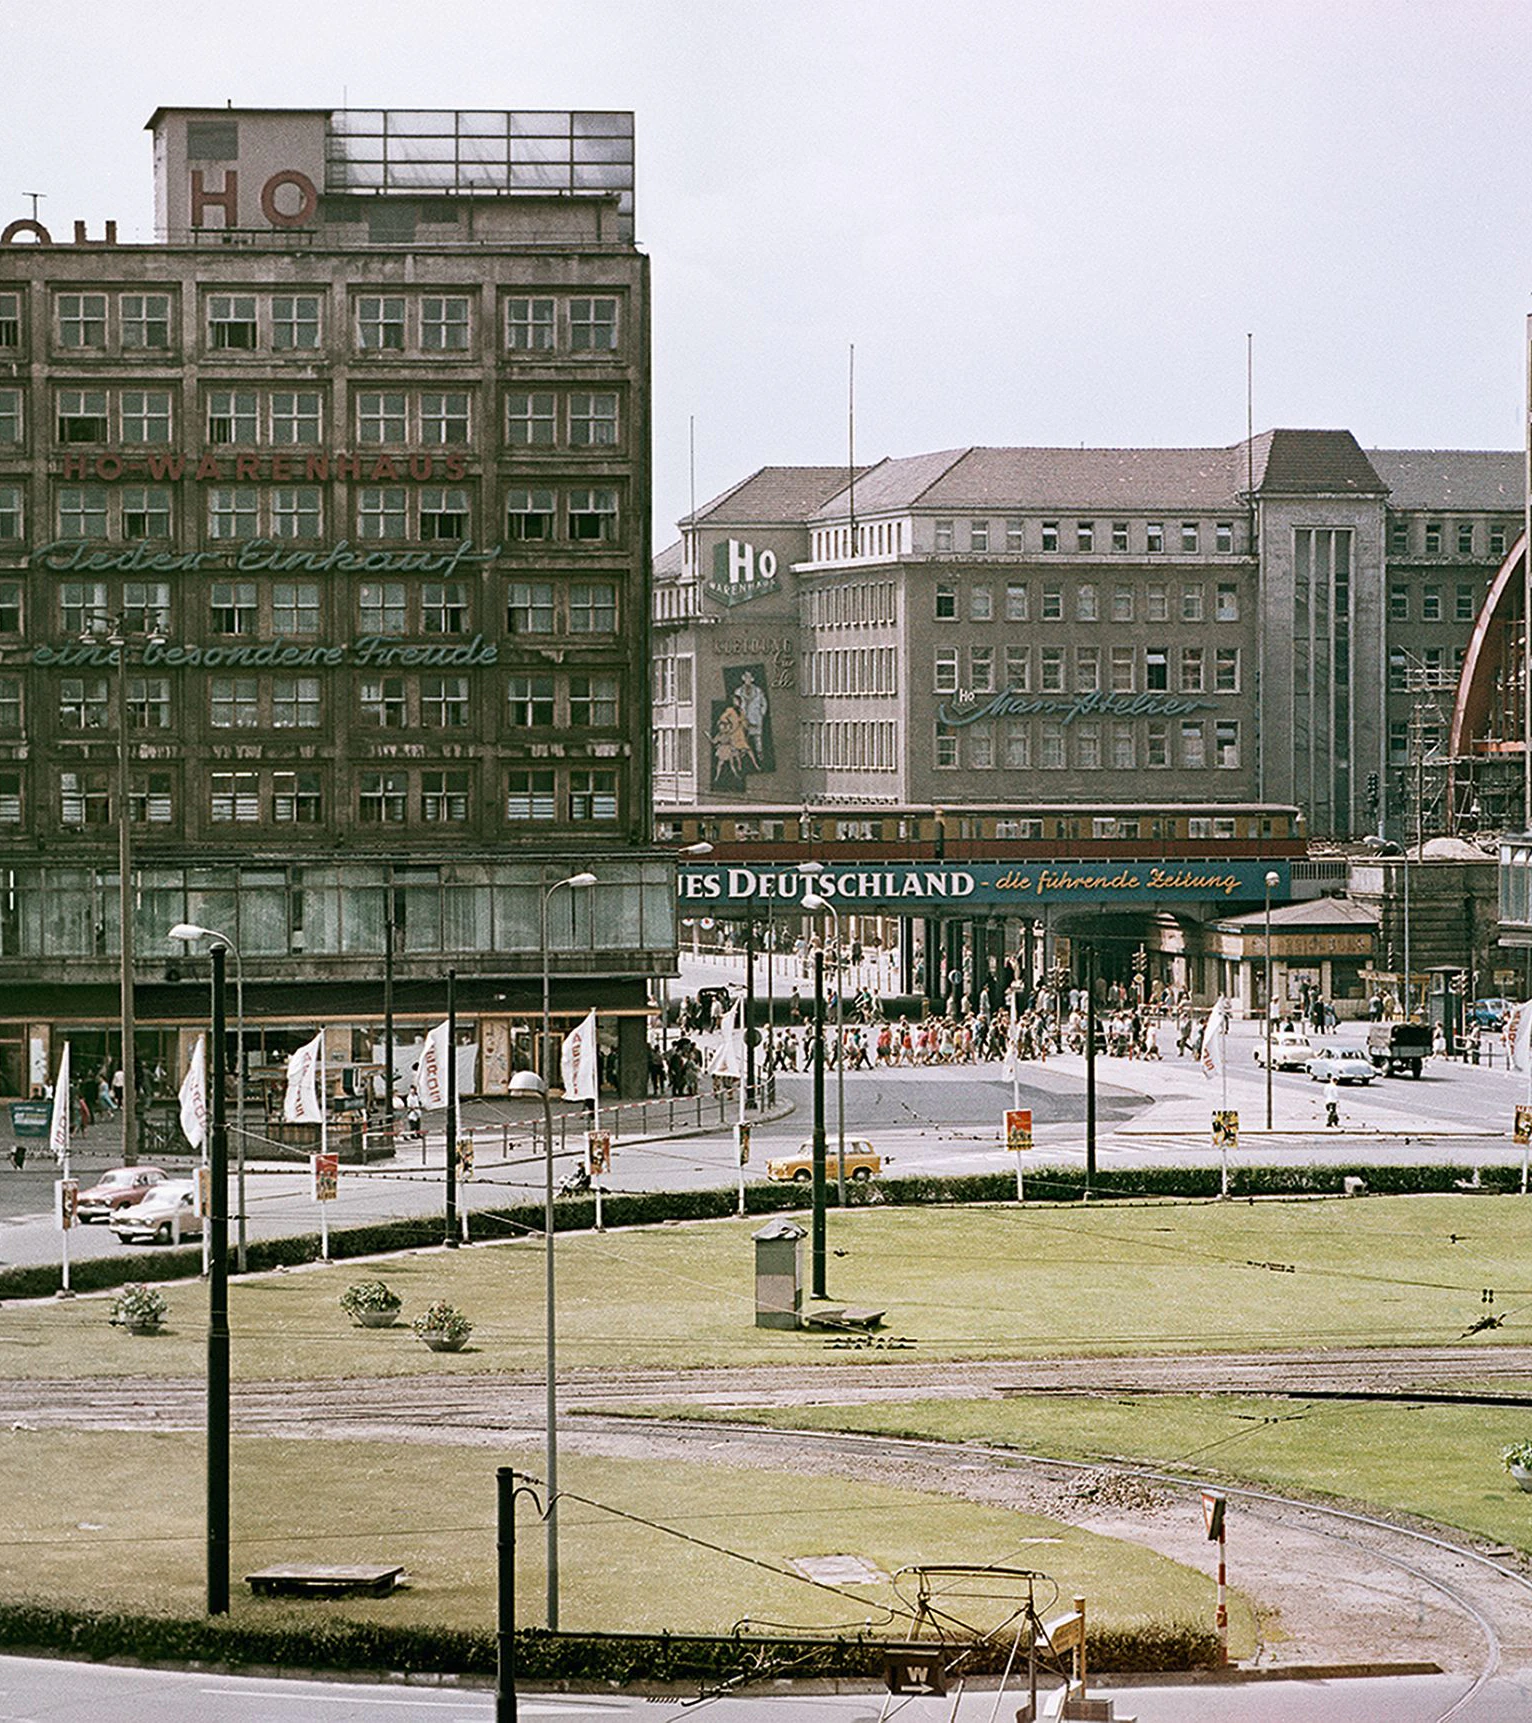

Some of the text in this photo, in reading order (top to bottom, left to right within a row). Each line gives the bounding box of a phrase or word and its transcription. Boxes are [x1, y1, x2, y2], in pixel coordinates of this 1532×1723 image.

[190, 170, 318, 229] HO
[62, 452, 469, 482] HO-WARENHAUS
[33, 538, 500, 578] Jeder Einkauf
[32, 633, 499, 667] eine besondere Freude
[726, 868, 975, 899] DEUTSCHLAND
[995, 871, 1032, 890] die
[1036, 870, 1140, 895] führende
[1146, 868, 1242, 895] Zeitung
[907, 1666, 929, 1683] W
